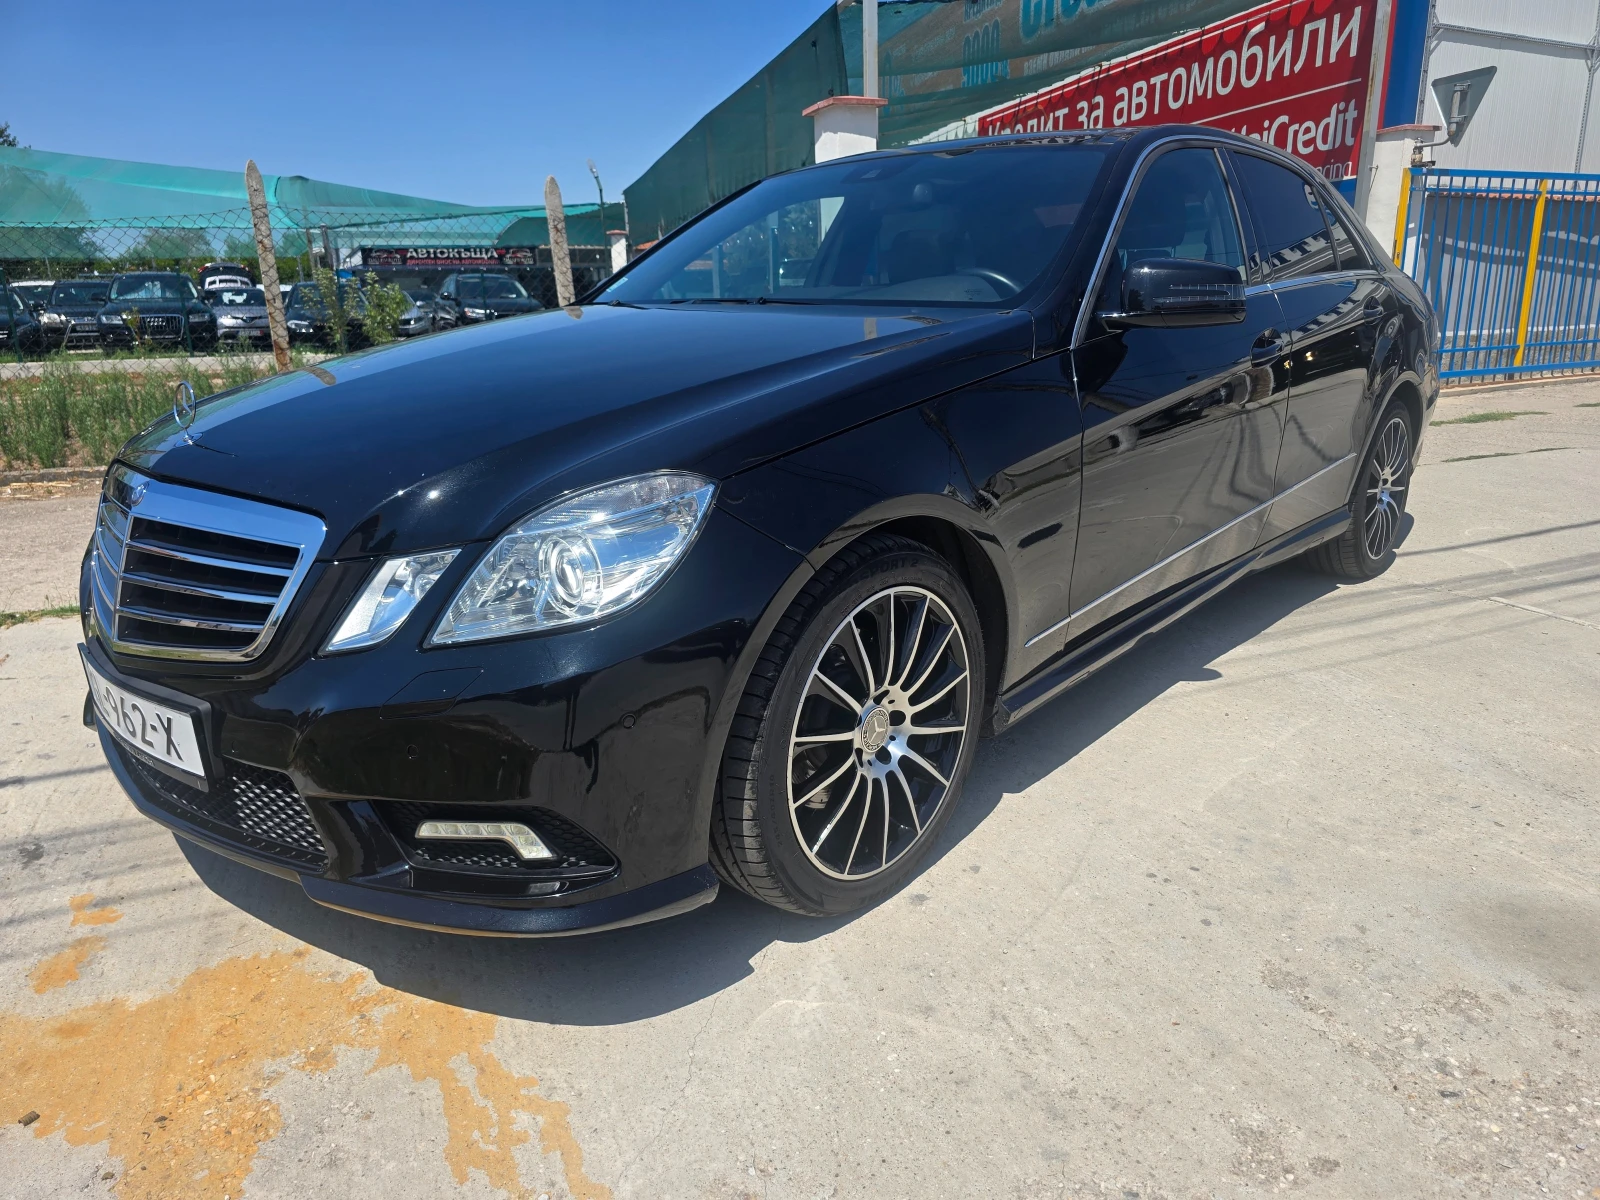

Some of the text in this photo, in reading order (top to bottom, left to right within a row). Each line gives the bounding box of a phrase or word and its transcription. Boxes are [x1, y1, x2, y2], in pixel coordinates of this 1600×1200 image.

[1076, 95, 1104, 129] за
[1112, 5, 1363, 122] автомобили
[1231, 98, 1358, 155] iCredit
[406, 247, 499, 260] АВТОКЪЩА
